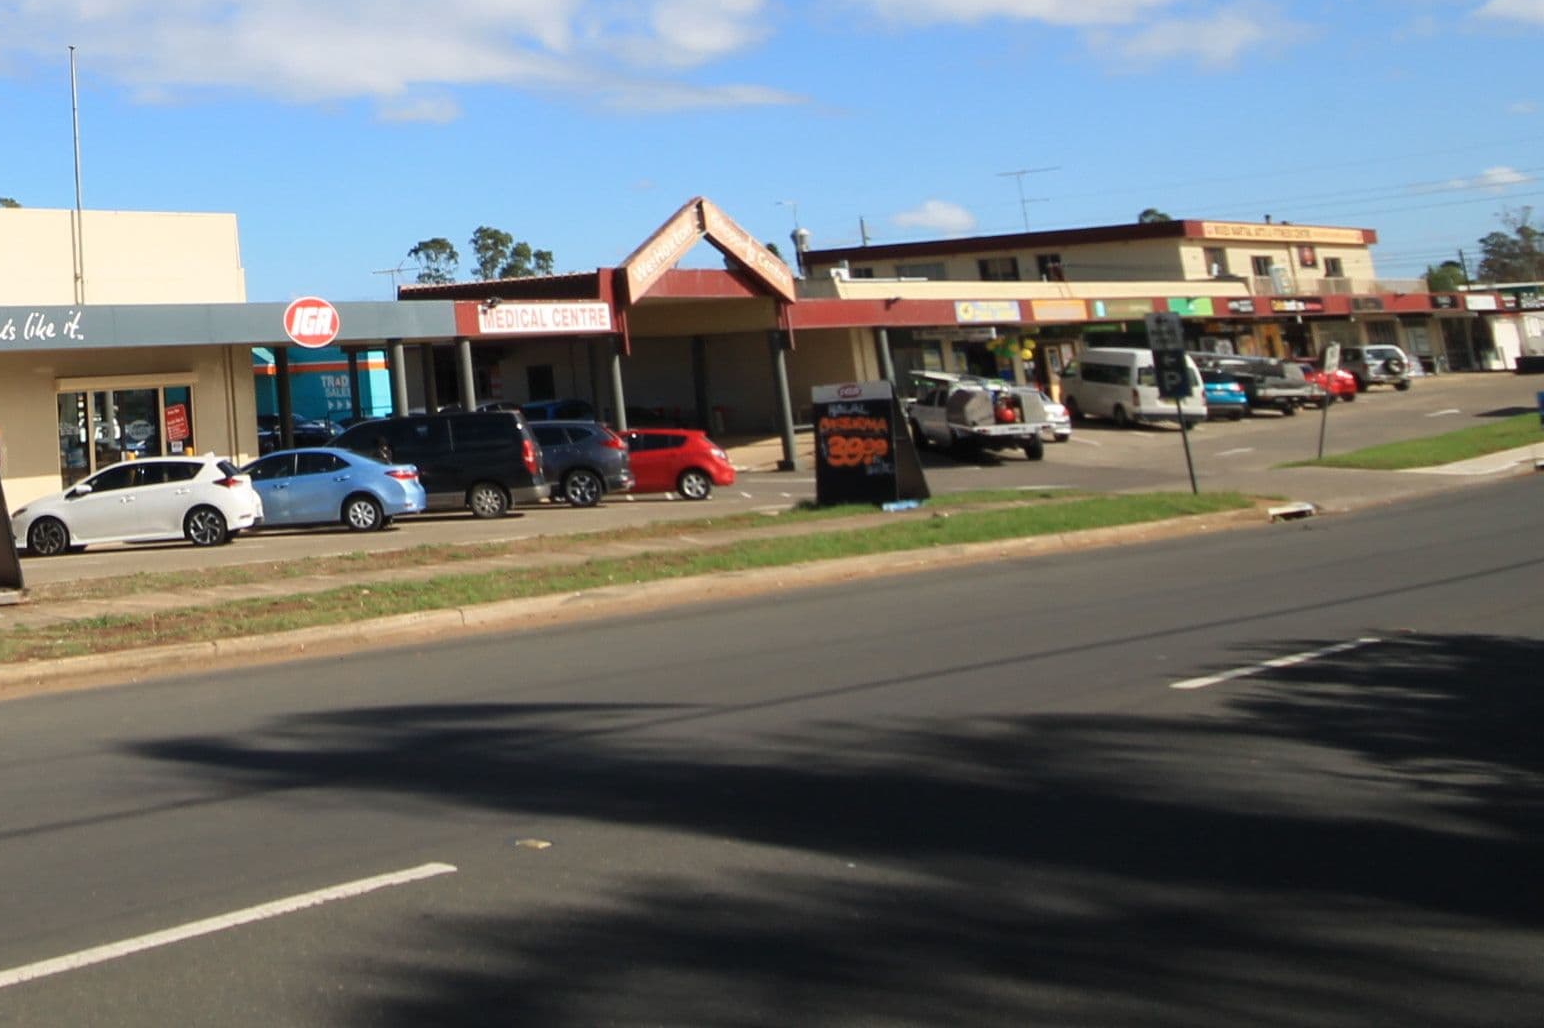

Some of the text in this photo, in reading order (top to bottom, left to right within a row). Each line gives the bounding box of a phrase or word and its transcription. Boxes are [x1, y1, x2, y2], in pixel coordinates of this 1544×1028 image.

[23, 311, 57, 341] like
[291, 307, 332, 335] IGA
[483, 306, 607, 330] MEDICAL CENTRE
[321, 375, 350, 388] TRAD
